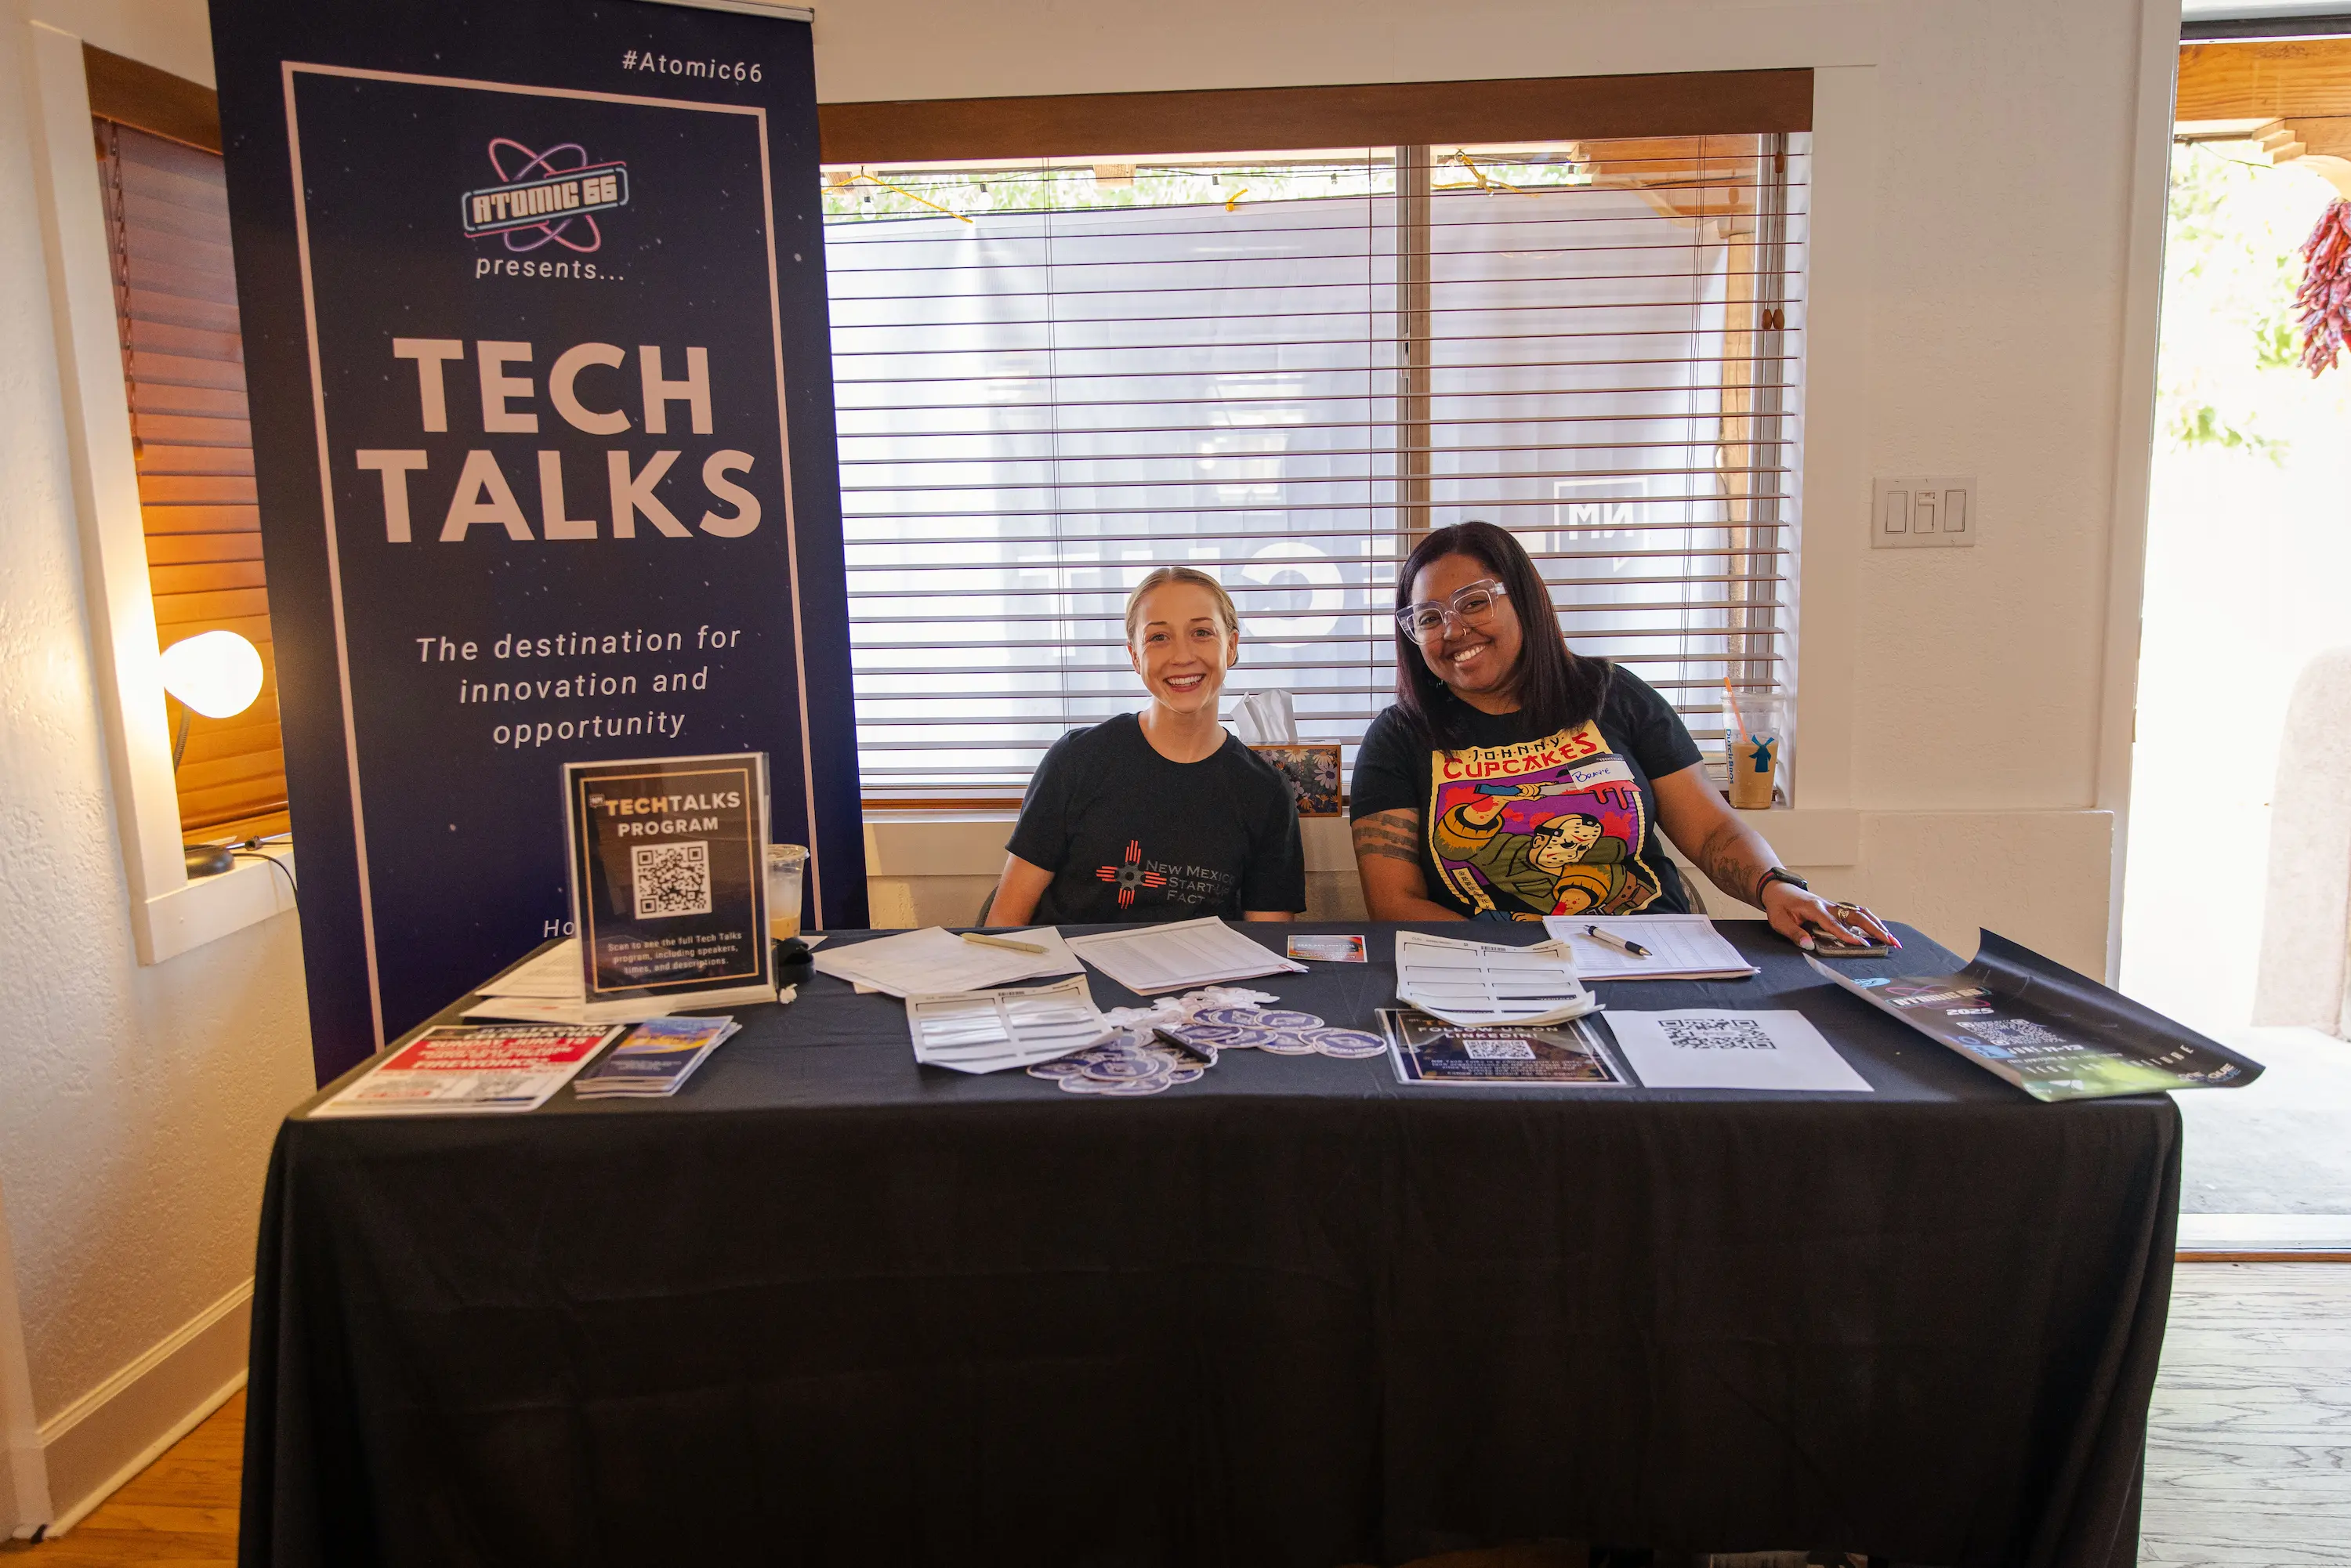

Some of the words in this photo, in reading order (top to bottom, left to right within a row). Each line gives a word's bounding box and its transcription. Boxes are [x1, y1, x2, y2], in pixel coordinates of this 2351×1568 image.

[622, 50, 762, 83] #Atomic66
[473, 181, 579, 223] ATOMIC
[582, 175, 618, 205] 66
[475, 257, 625, 281] presents...
[393, 338, 713, 435] TECH
[356, 449, 761, 542] TALKS
[415, 636, 478, 662] The
[494, 628, 683, 660] destination
[697, 625, 741, 650] for
[459, 672, 637, 704] innovation
[653, 666, 708, 693] and
[493, 711, 686, 749] opportunity
[1443, 732, 1598, 780] CUPCAKES
[605, 791, 741, 816] TECHTALKS
[618, 817, 719, 837] PROGRAM
[1146, 859, 1183, 875] NEW
[1166, 890, 1205, 904] FACT
[544, 918, 575, 938] Ho
[608, 943, 629, 951] Scan
[661, 938, 676, 947] the
[677, 936, 694, 946] full
[696, 934, 717, 943] Tech
[719, 932, 742, 941] Talks
[613, 954, 653, 965] program,
[655, 949, 695, 959] including
[697, 945, 738, 955] speakers,
[624, 965, 652, 975] times,
[654, 961, 671, 972] and
[673, 958, 729, 970] descriptions.
